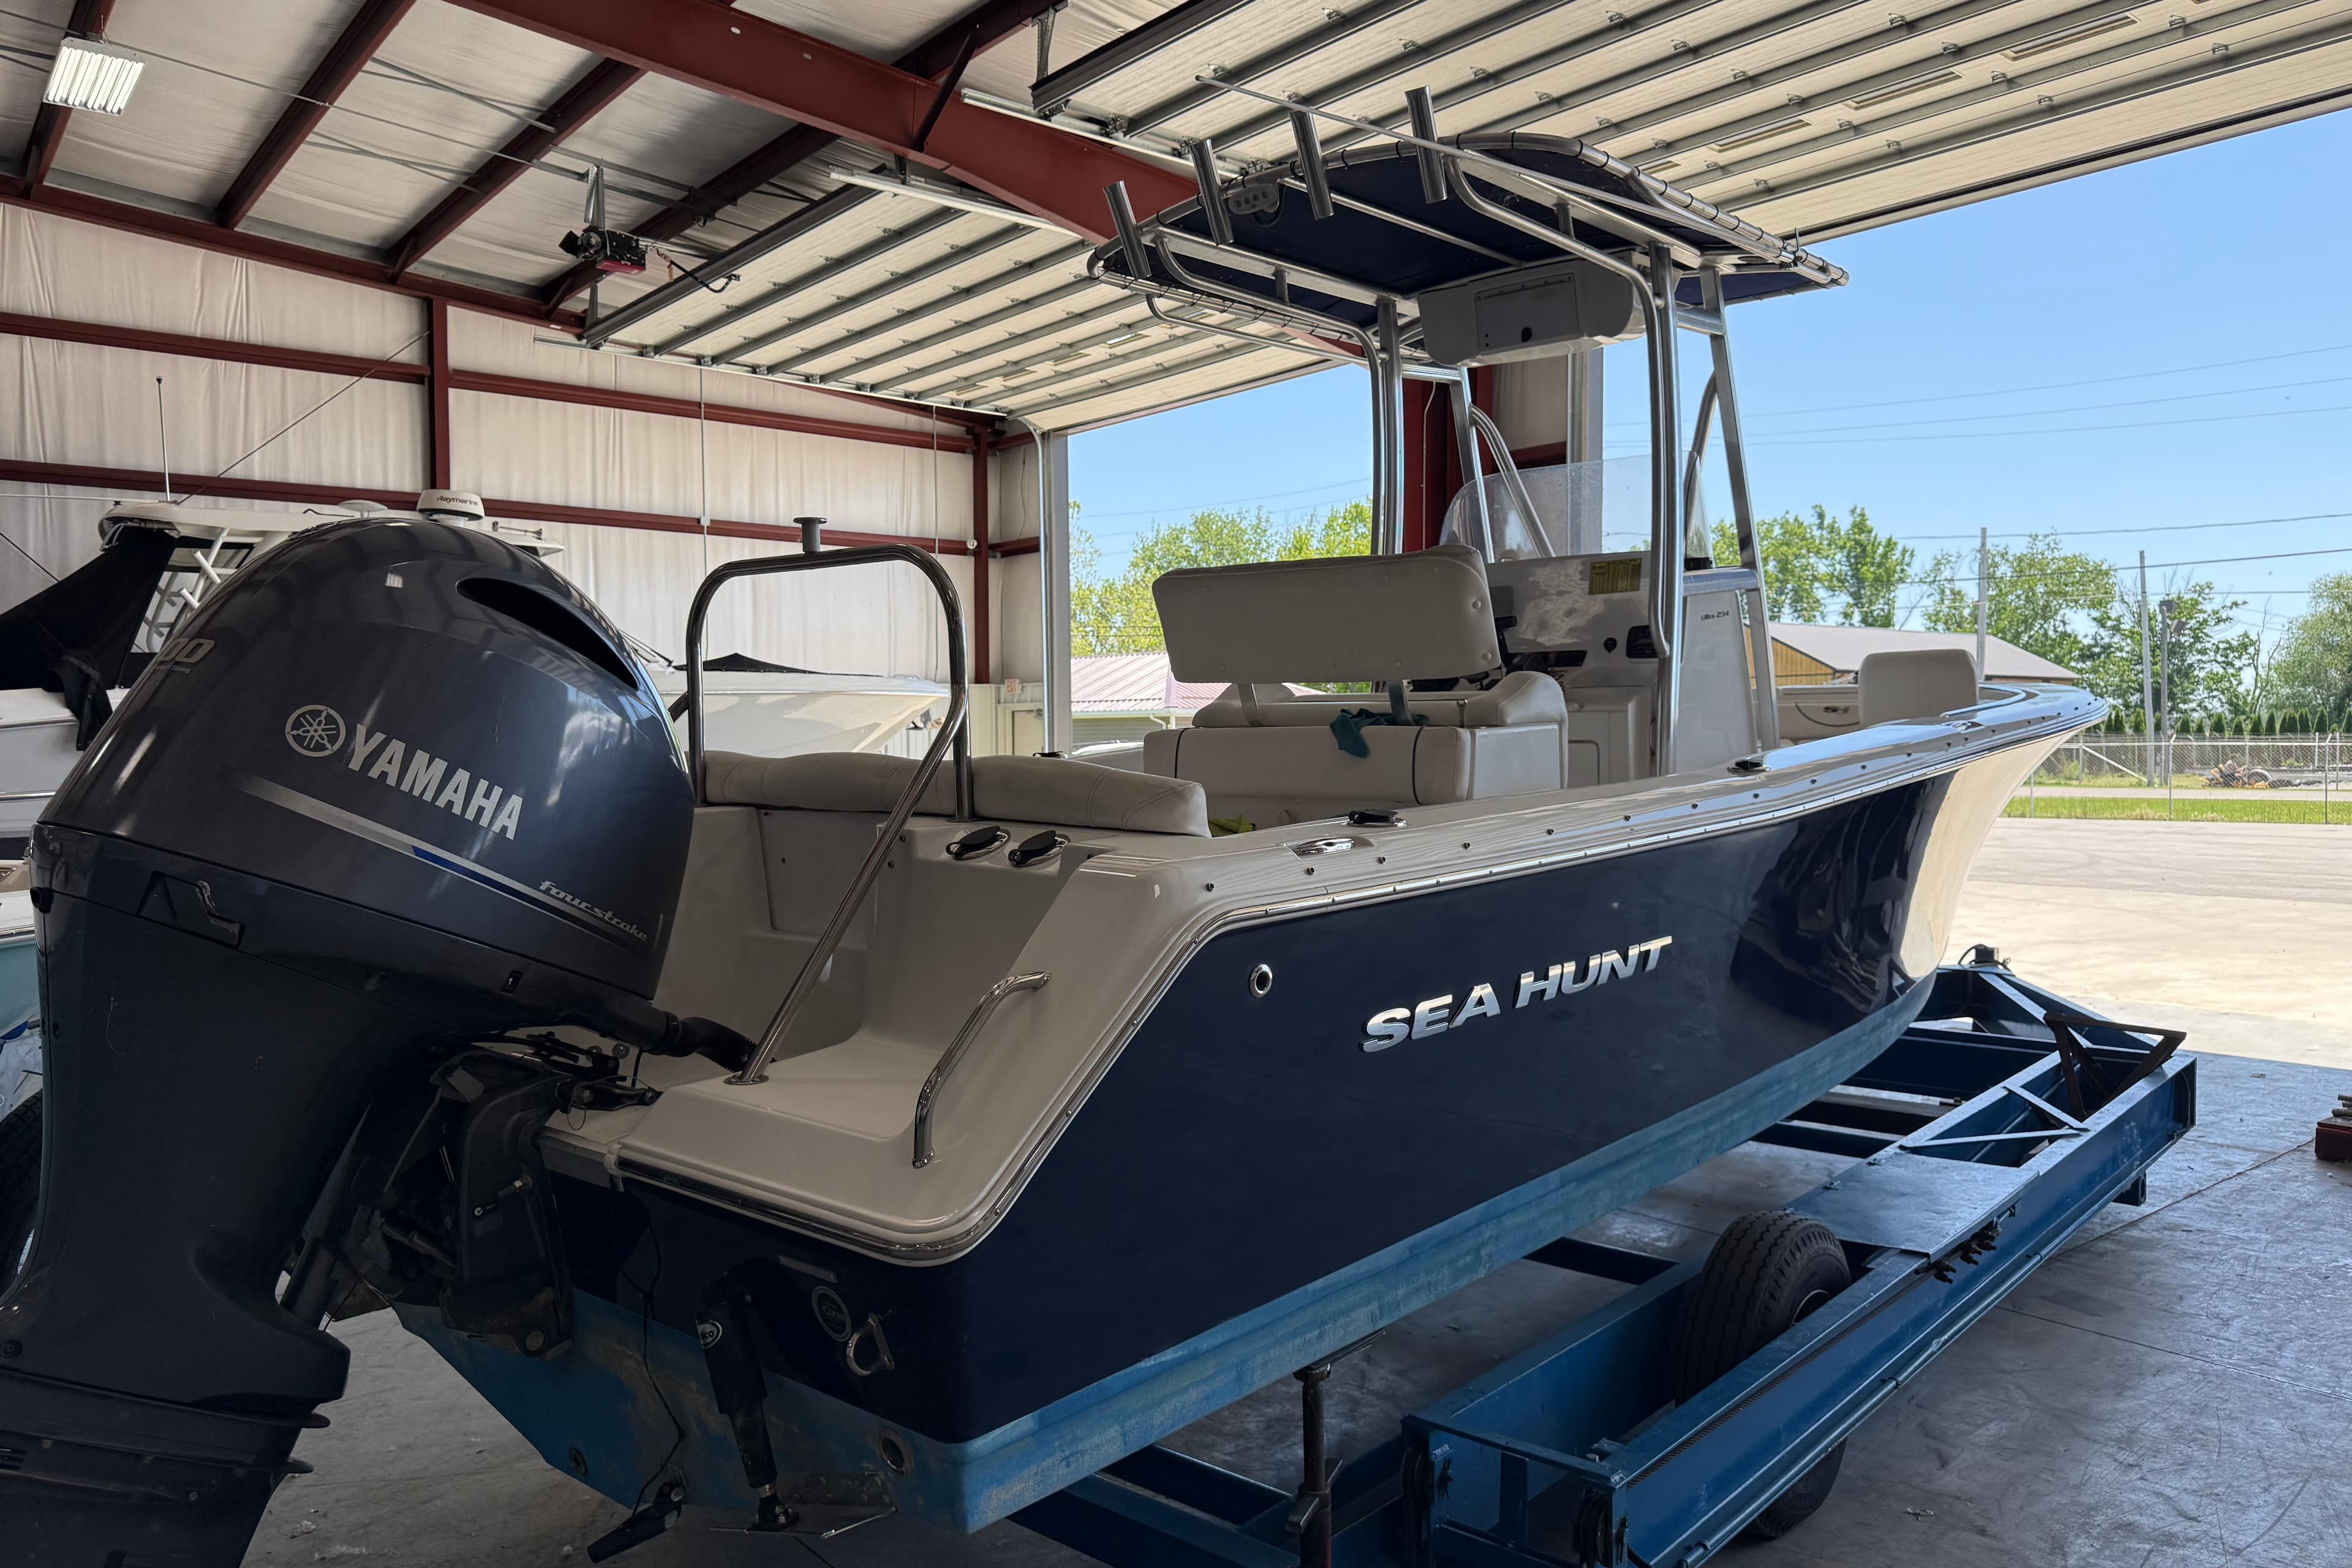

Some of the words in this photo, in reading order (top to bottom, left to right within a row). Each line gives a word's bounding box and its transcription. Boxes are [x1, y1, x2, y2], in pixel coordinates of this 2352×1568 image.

[436, 495, 479, 506] Raymarine
[348, 723, 524, 841] YAMAHA
[1360, 982, 1501, 1054] SEA
[1512, 935, 1673, 1009] HUNT
